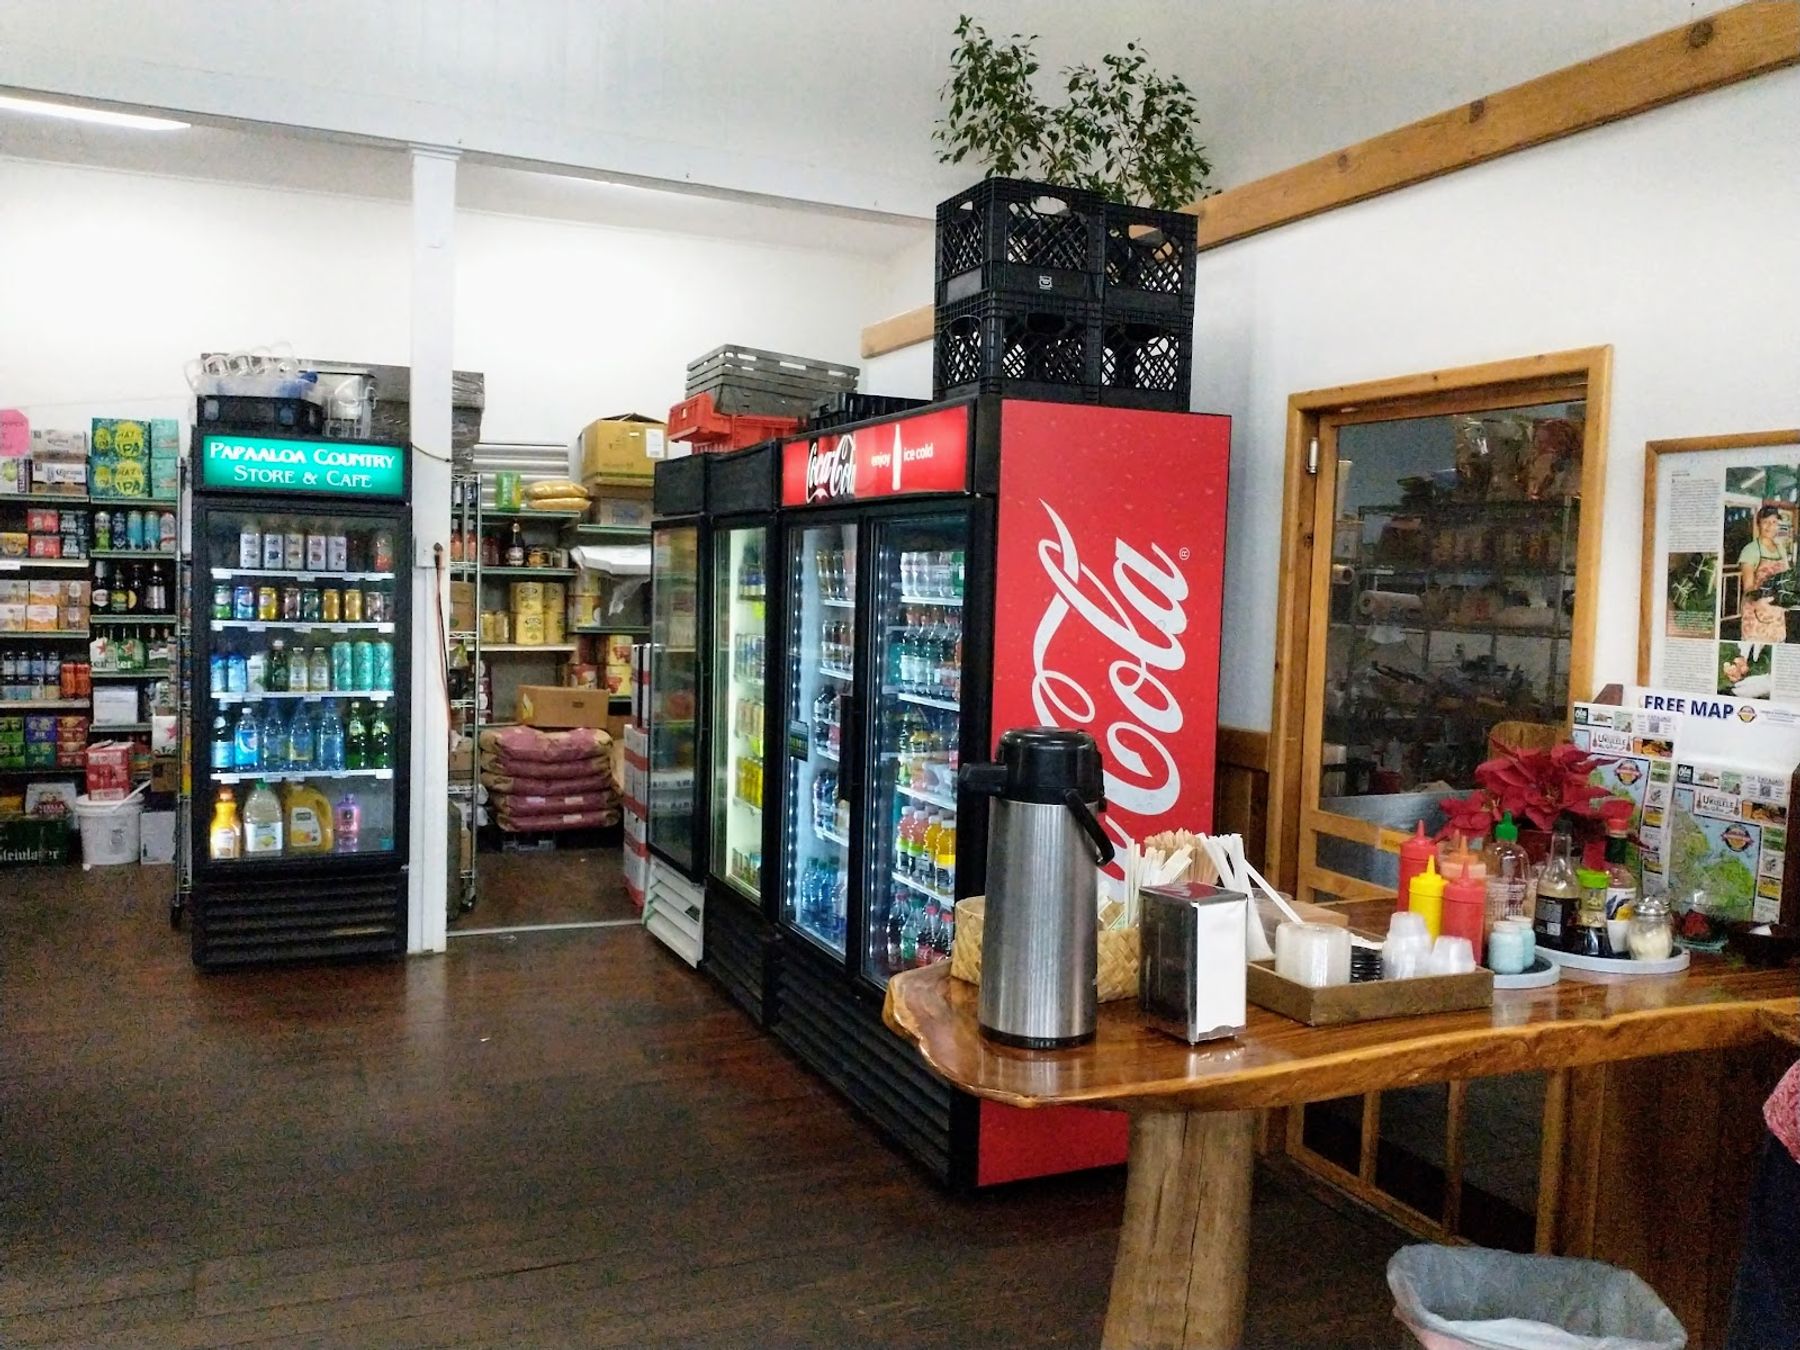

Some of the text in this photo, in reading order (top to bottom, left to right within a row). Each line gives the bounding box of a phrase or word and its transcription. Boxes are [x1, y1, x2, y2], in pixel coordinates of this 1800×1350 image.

[313, 448, 396, 469] COUNTRY
[870, 454, 891, 468] enjoy
[903, 443, 934, 462] ice cold
[234, 464, 296, 484] STORE
[302, 471, 318, 485] &
[806, 434, 857, 504] Coca-Cola
[1644, 695, 1686, 713] FREE
[1690, 699, 1735, 720] MAP
[0, 847, 59, 862] teinlaer
